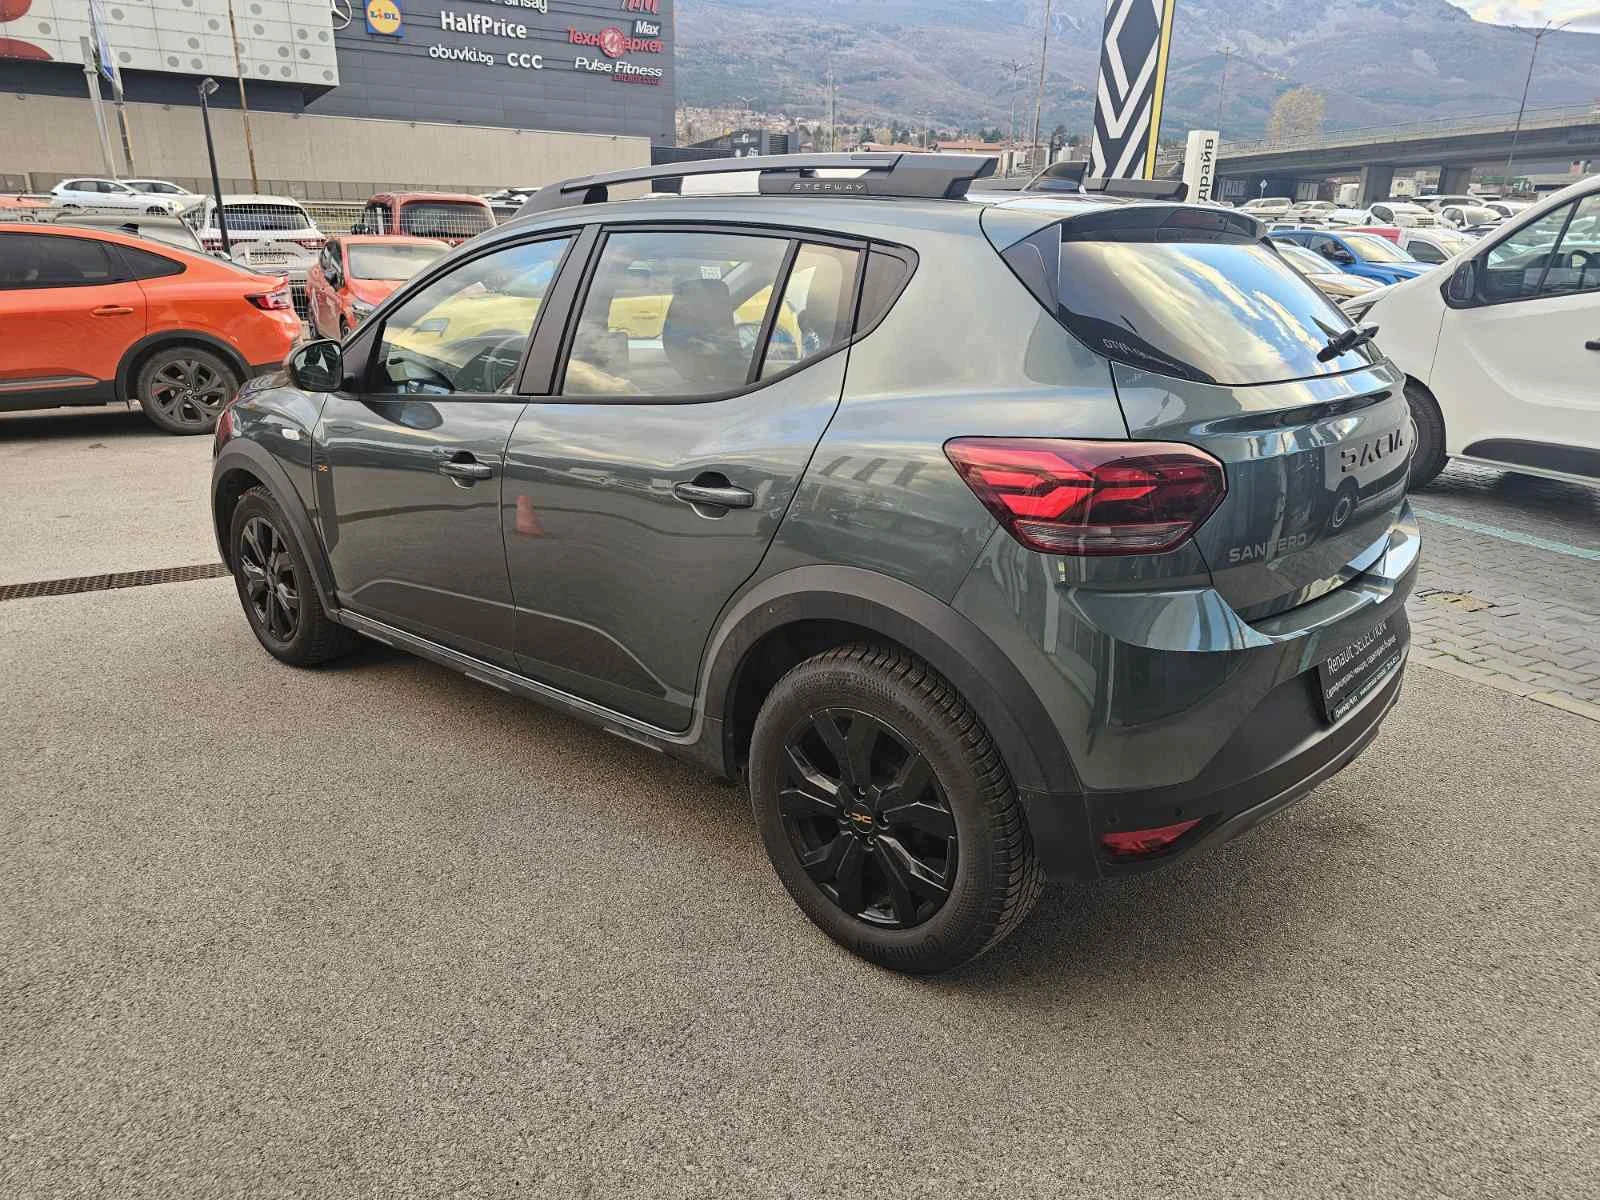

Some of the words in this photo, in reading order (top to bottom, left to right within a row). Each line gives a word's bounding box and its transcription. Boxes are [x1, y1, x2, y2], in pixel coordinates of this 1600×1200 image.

[440, 11, 527, 38] HalfPrice
[636, 21, 660, 35] Max
[429, 44, 494, 66] obuvki.bg
[507, 52, 543, 69] CCC
[575, 57, 612, 73] Pulse
[615, 62, 663, 77] Fitness
[1197, 138, 1214, 201] драйв
[793, 183, 865, 191] STEPWAY
[1327, 645, 1355, 676] Renault
